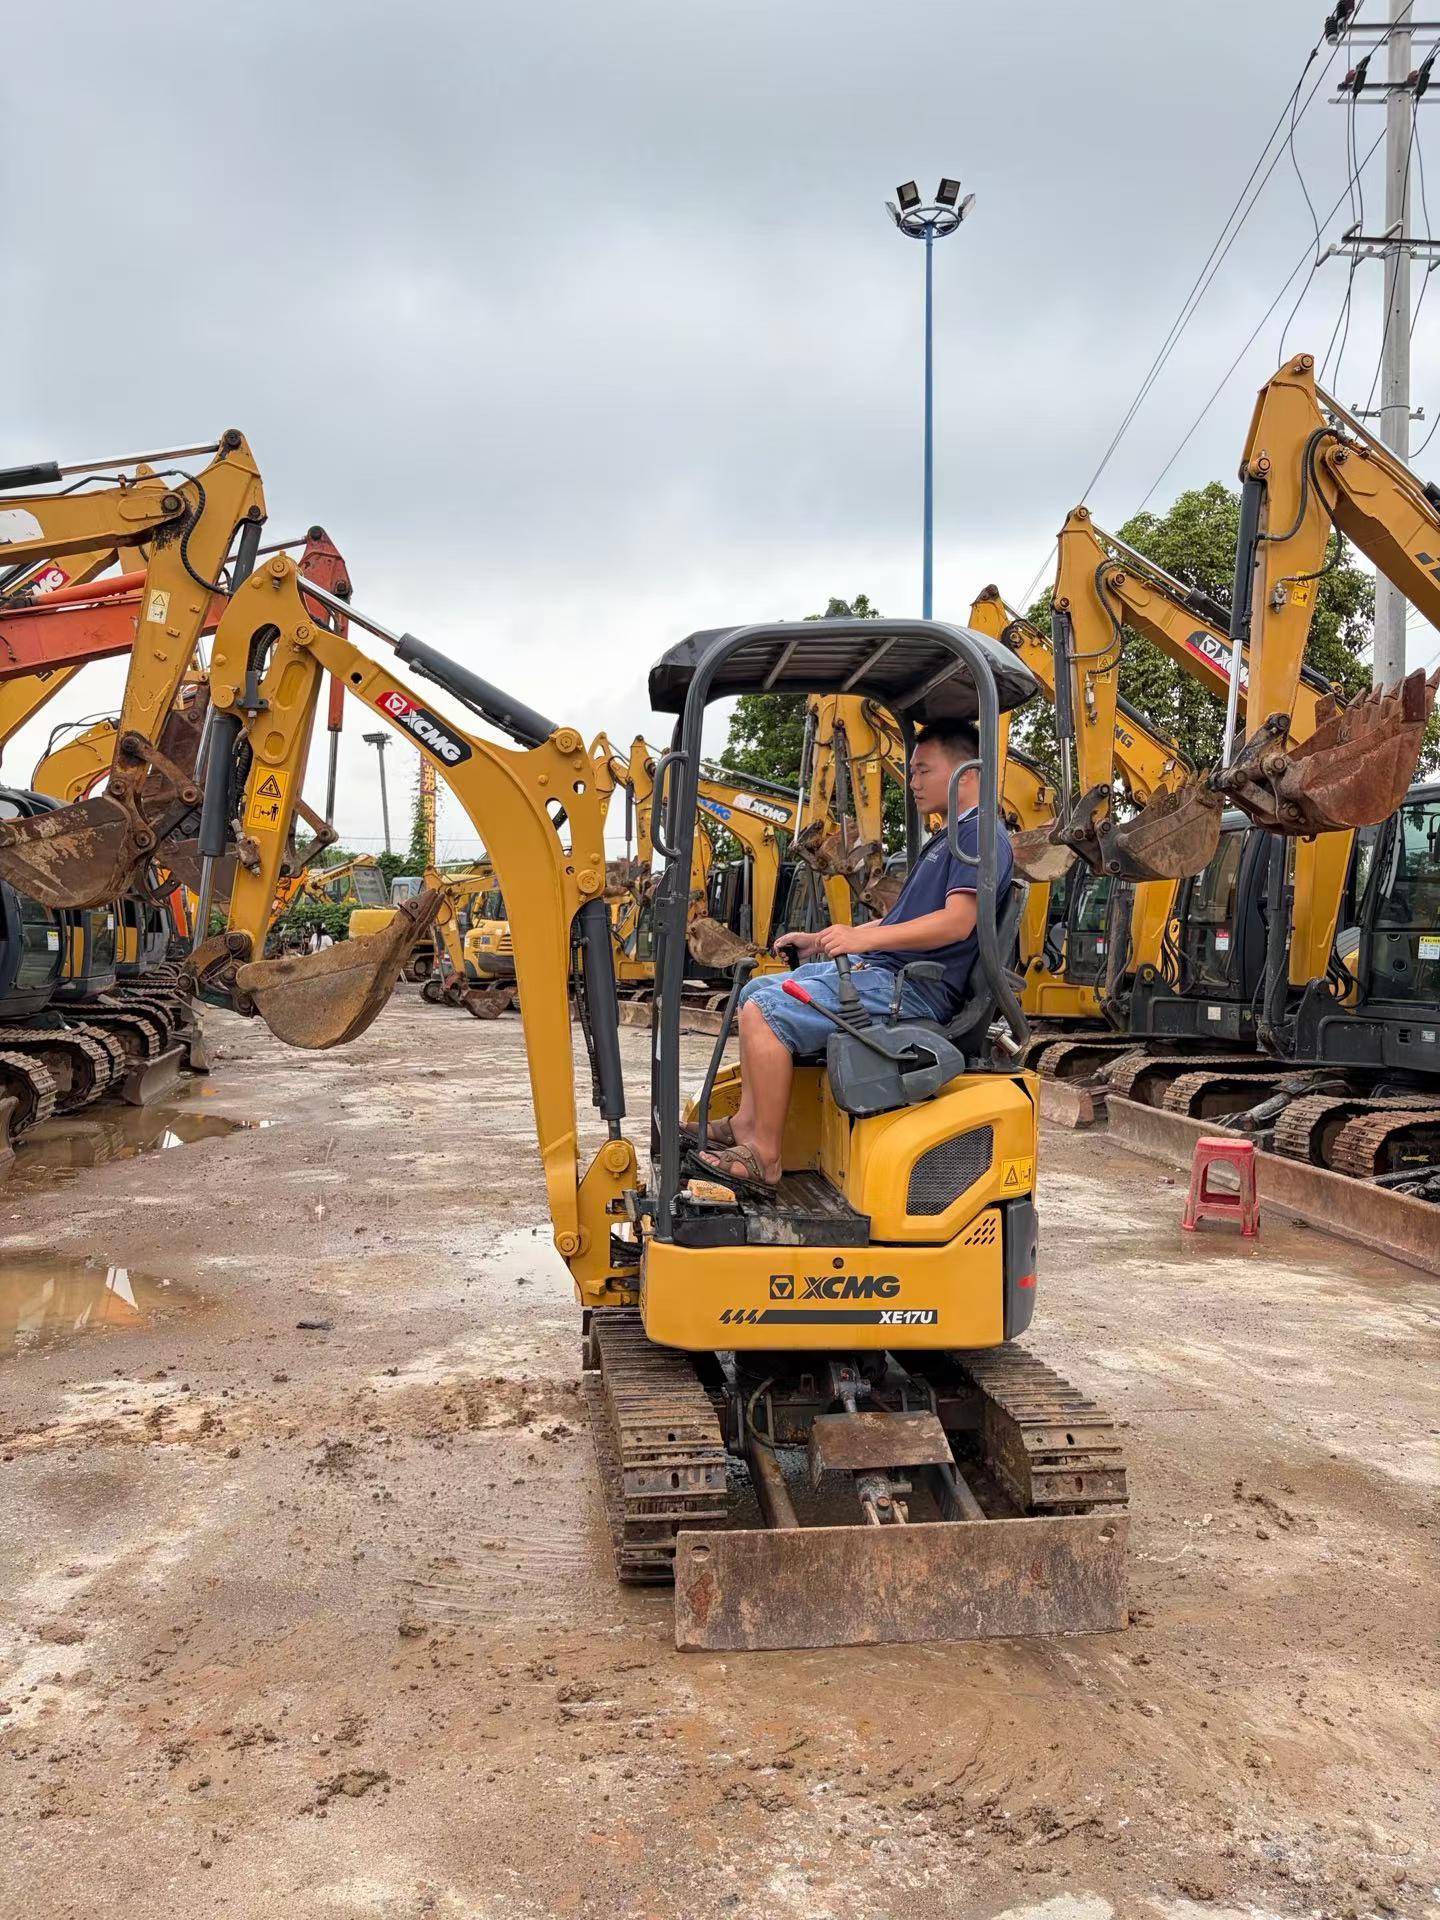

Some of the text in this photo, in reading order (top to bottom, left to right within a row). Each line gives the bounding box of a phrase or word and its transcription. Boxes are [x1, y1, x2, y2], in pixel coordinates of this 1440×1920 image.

[398, 708, 461, 761] XCMG
[751, 800, 788, 823] XCMG
[798, 1276, 900, 1299] XCMG
[879, 1311, 933, 1324] XE17U
